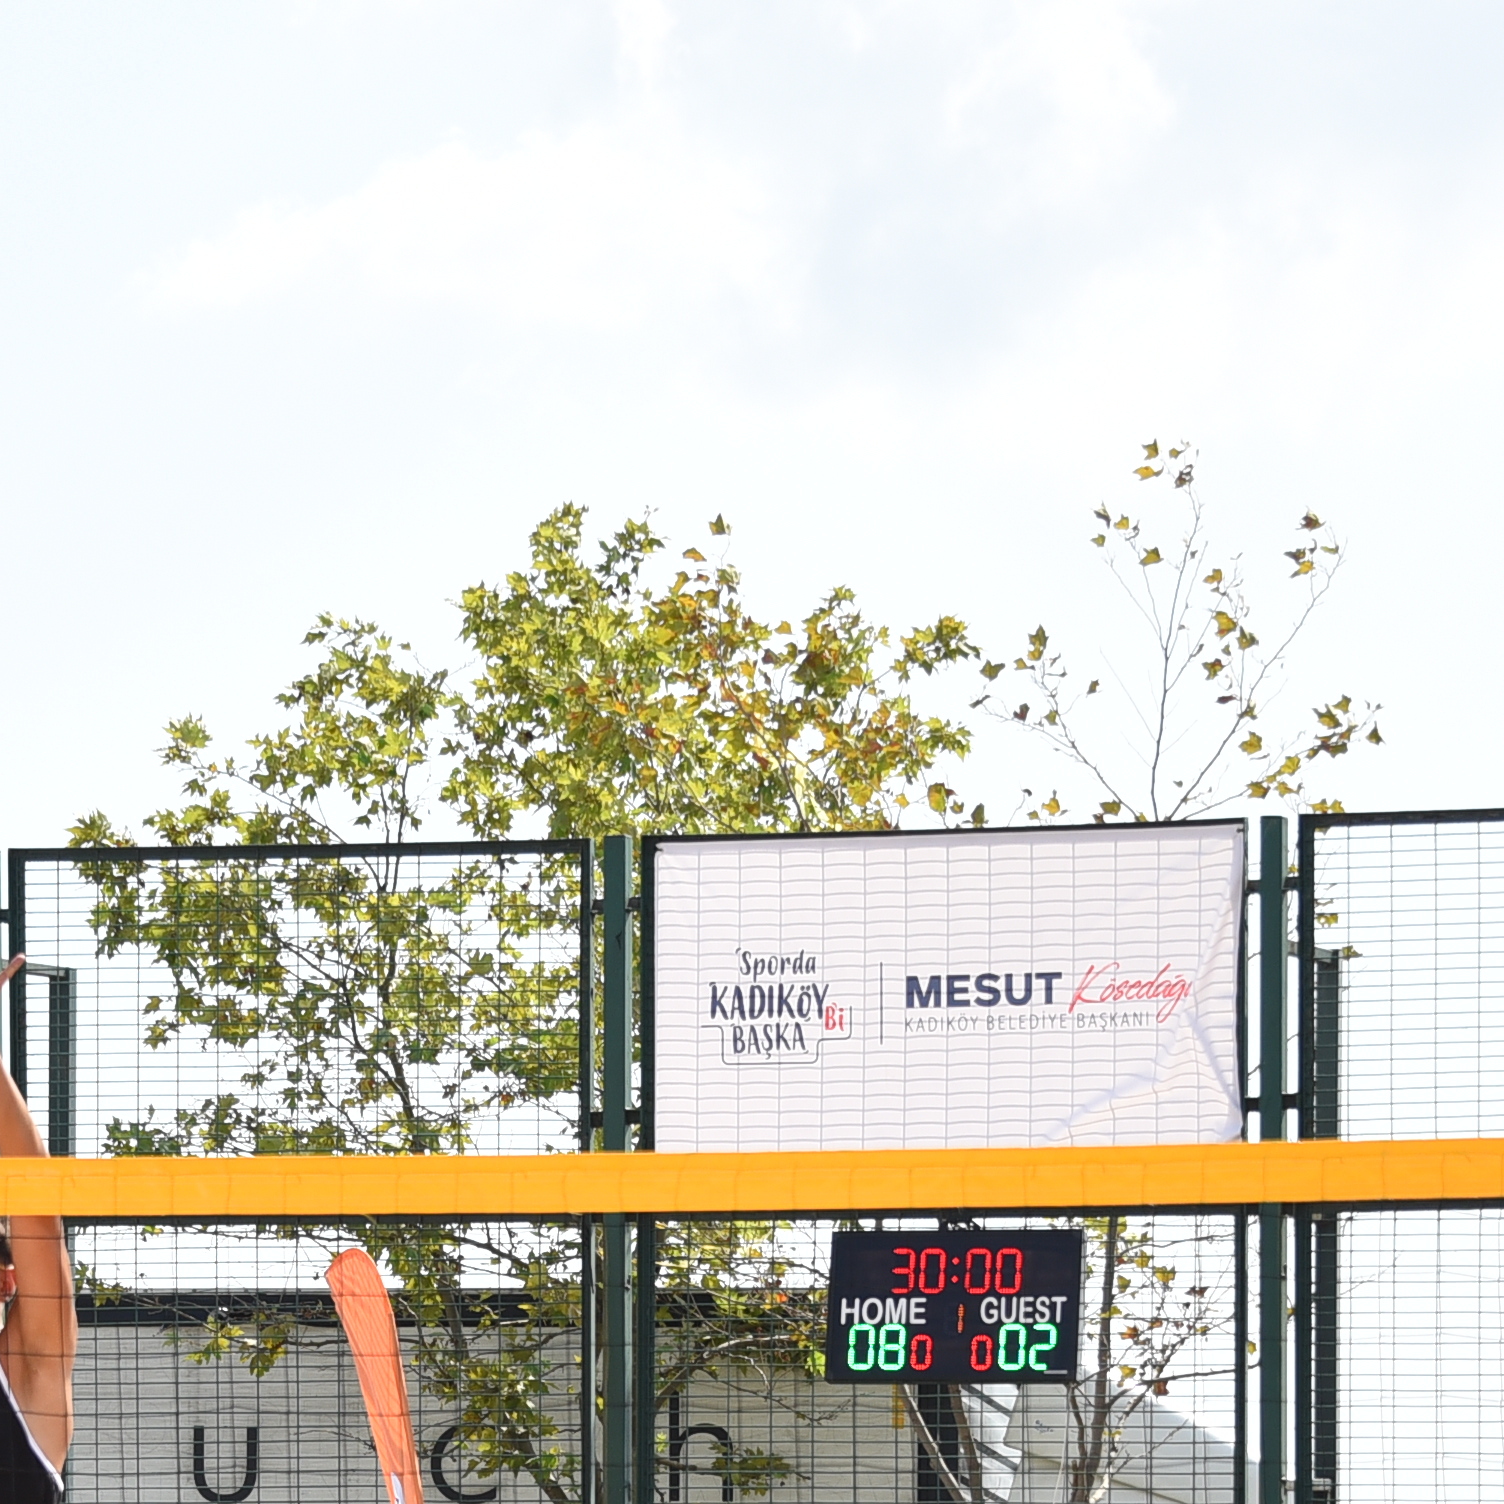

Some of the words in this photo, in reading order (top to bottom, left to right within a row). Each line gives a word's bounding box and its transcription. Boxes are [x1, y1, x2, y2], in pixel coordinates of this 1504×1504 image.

[736, 948, 816, 983] Sporda
[709, 982, 829, 1021] KADIKÖY
[905, 972, 1063, 1008] MESUT
[905, 1012, 979, 1033] KADIKÖY
[986, 1010, 1068, 1032] BELEDİYE
[1076, 1012, 1149, 1032] BAŞKANI
[732, 1022, 807, 1060] BAŞKA
[891, 1247, 1023, 1295] 30:00
[840, 1297, 927, 1325] HOME
[979, 1296, 1068, 1324] GUEST
[847, 1323, 907, 1371] 08
[997, 1323, 1058, 1372] 02
